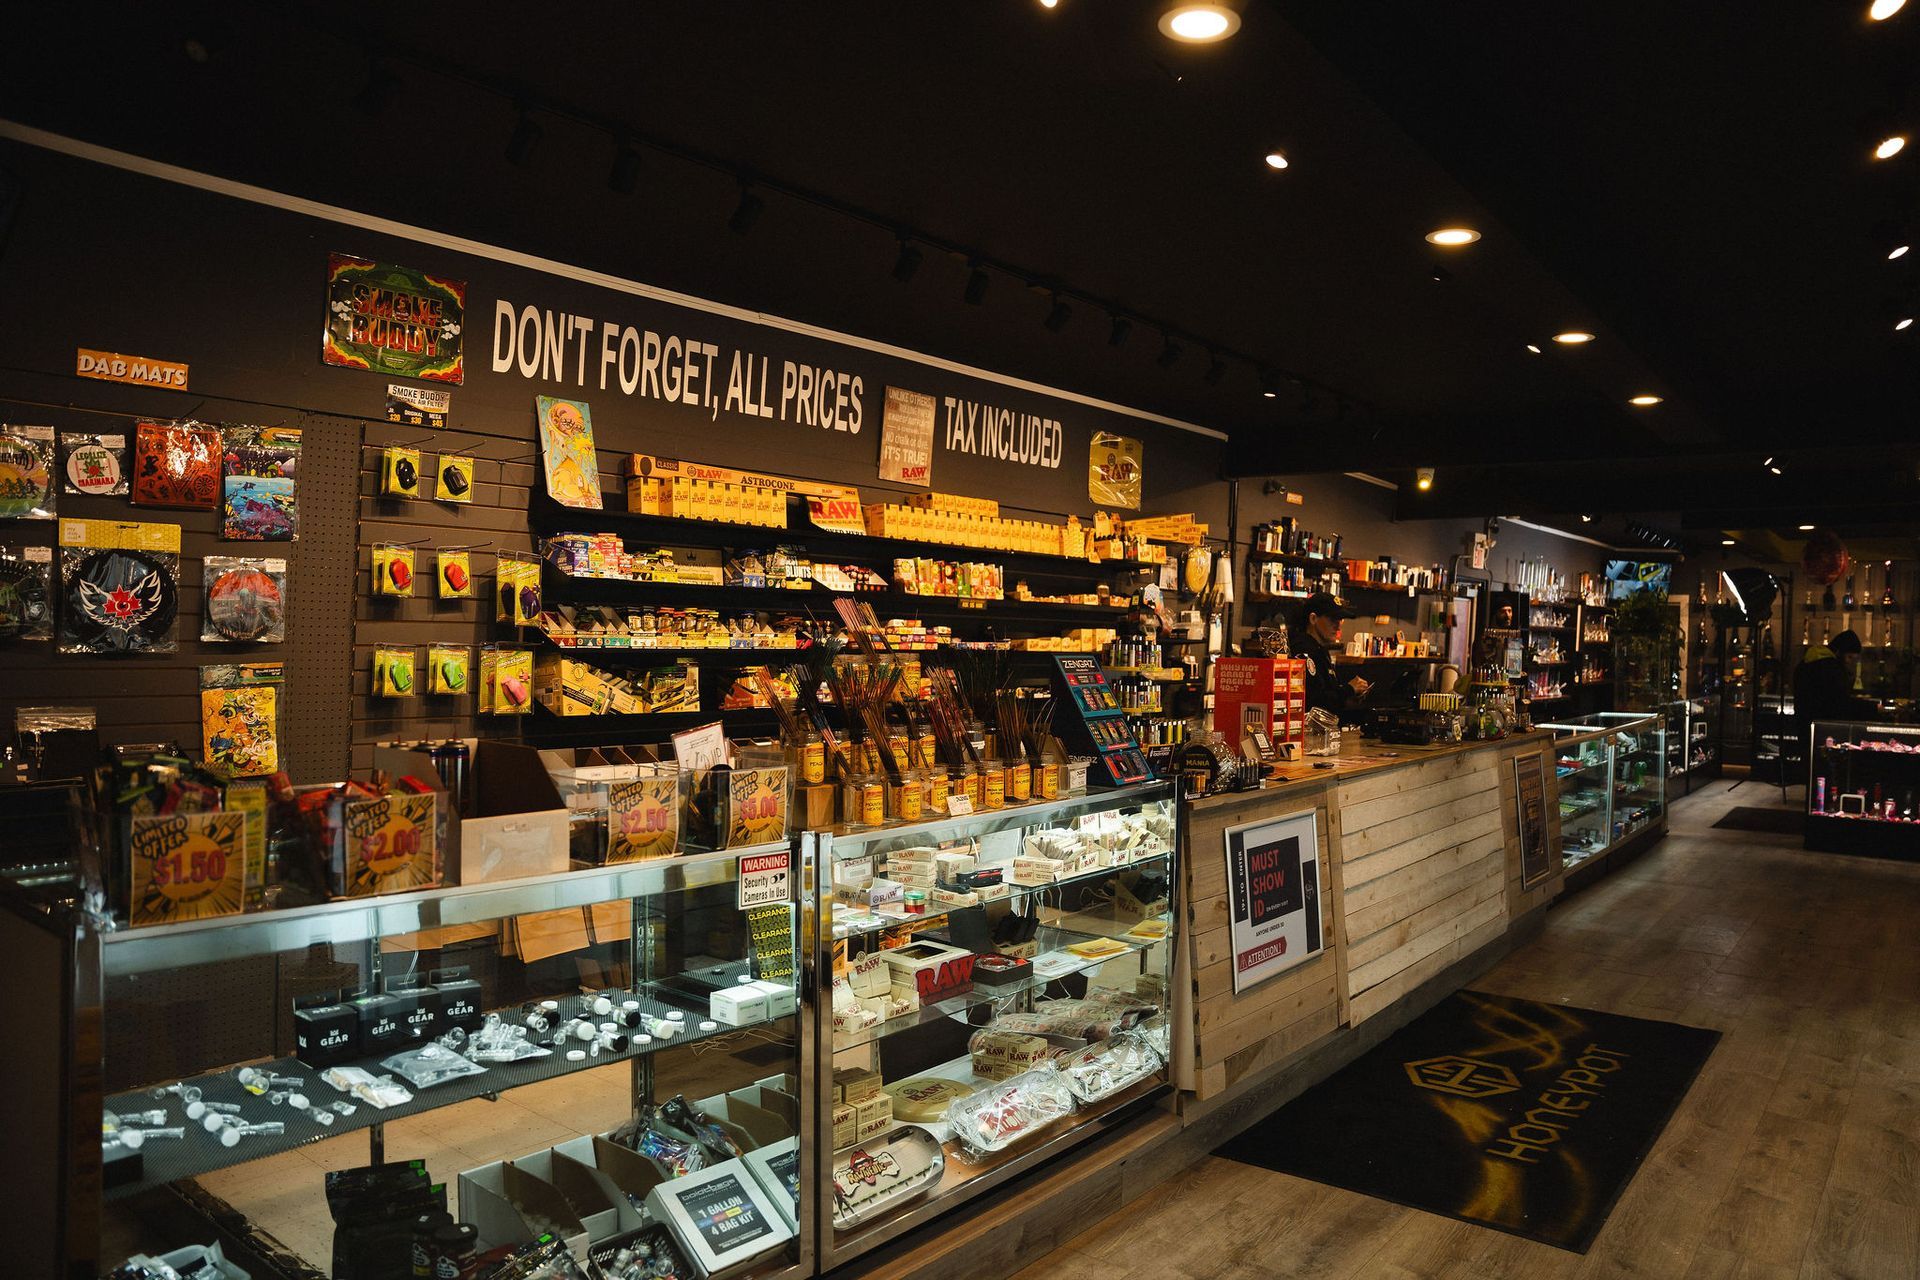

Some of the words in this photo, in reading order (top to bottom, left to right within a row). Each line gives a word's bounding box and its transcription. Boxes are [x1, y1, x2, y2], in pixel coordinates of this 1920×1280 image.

[352, 283, 442, 328] SMOKE
[351, 314, 442, 357] BUDDY
[79, 355, 128, 377] DAB
[131, 363, 187, 386] MATS
[492, 299, 594, 387] DON'T
[600, 321, 719, 421] FORGET,
[725, 351, 773, 419] ALL
[780, 364, 864, 436] PRICES
[944, 396, 979, 455] TAX
[981, 404, 1063, 469] INCLUDED
[392, 386, 418, 398] SMOKE
[420, 391, 445, 401] BUDDY
[885, 445, 901, 460] IT'S
[903, 448, 928, 466] TRUE!
[657, 460, 677, 470] CLASSIC
[696, 468, 722, 479] RAW
[902, 467, 927, 478] RAW
[1100, 463, 1134, 480] RAW
[740, 475, 796, 491] ASTROCONE
[810, 501, 858, 518] RAW
[786, 564, 811, 579] BLUNTS
[1062, 660, 1094, 668] ZENGAZ
[732, 772, 758, 793] LIMITED
[610, 781, 642, 805] LIMITED
[736, 783, 758, 801] OFFER
[617, 794, 643, 812] OFFER
[740, 795, 777, 821] $5.00
[346, 801, 389, 829] LIMITED
[621, 807, 667, 834] $2.50
[132, 816, 187, 847] LIMITED
[353, 818, 389, 838] OFFER
[143, 833, 188, 857] OFFER
[362, 829, 421, 860] $2.00
[155, 849, 225, 885] $1.50
[744, 854, 788, 871] WARNING
[1084, 857, 1095, 866] RAW
[1252, 850, 1279, 873] MUST
[744, 875, 768, 889] Security
[1253, 871, 1284, 895] SHOW
[744, 891, 768, 902] Cameras
[769, 888, 775, 898] In
[776, 888, 785, 898] Use
[879, 891, 897, 902] RAW
[748, 906, 790, 921] CLEARANCE
[1254, 899, 1264, 918] ID
[752, 926, 791, 940] CLEARANC
[1248, 943, 1282, 965] ATTENTION!
[760, 967, 793, 979] CLEARAN
[855, 956, 880, 975] RAW
[915, 954, 975, 999] RAW
[408, 1012, 434, 1024] GEAR
[447, 1005, 474, 1016] GEAR
[895, 1004, 911, 1015] RAW
[372, 1022, 396, 1035] GEAR
[863, 1017, 878, 1027] RAW
[320, 1033, 349, 1047] GEAR
[986, 1047, 1005, 1056] RAW
[1010, 1052, 1029, 1062] RAW
[1032, 1049, 1046, 1062] RAW
[973, 1064, 993, 1073] RAW
[906, 1084, 945, 1101] RAW
[1486, 1043, 1631, 1164] HONEYPOT
[867, 1118, 886, 1133] RAW
[698, 1209, 706, 1218] 1
[707, 1195, 743, 1215] GALLON
[711, 1225, 719, 1235] 4
[719, 1217, 739, 1233] BAG
[740, 1210, 754, 1225] KIT
